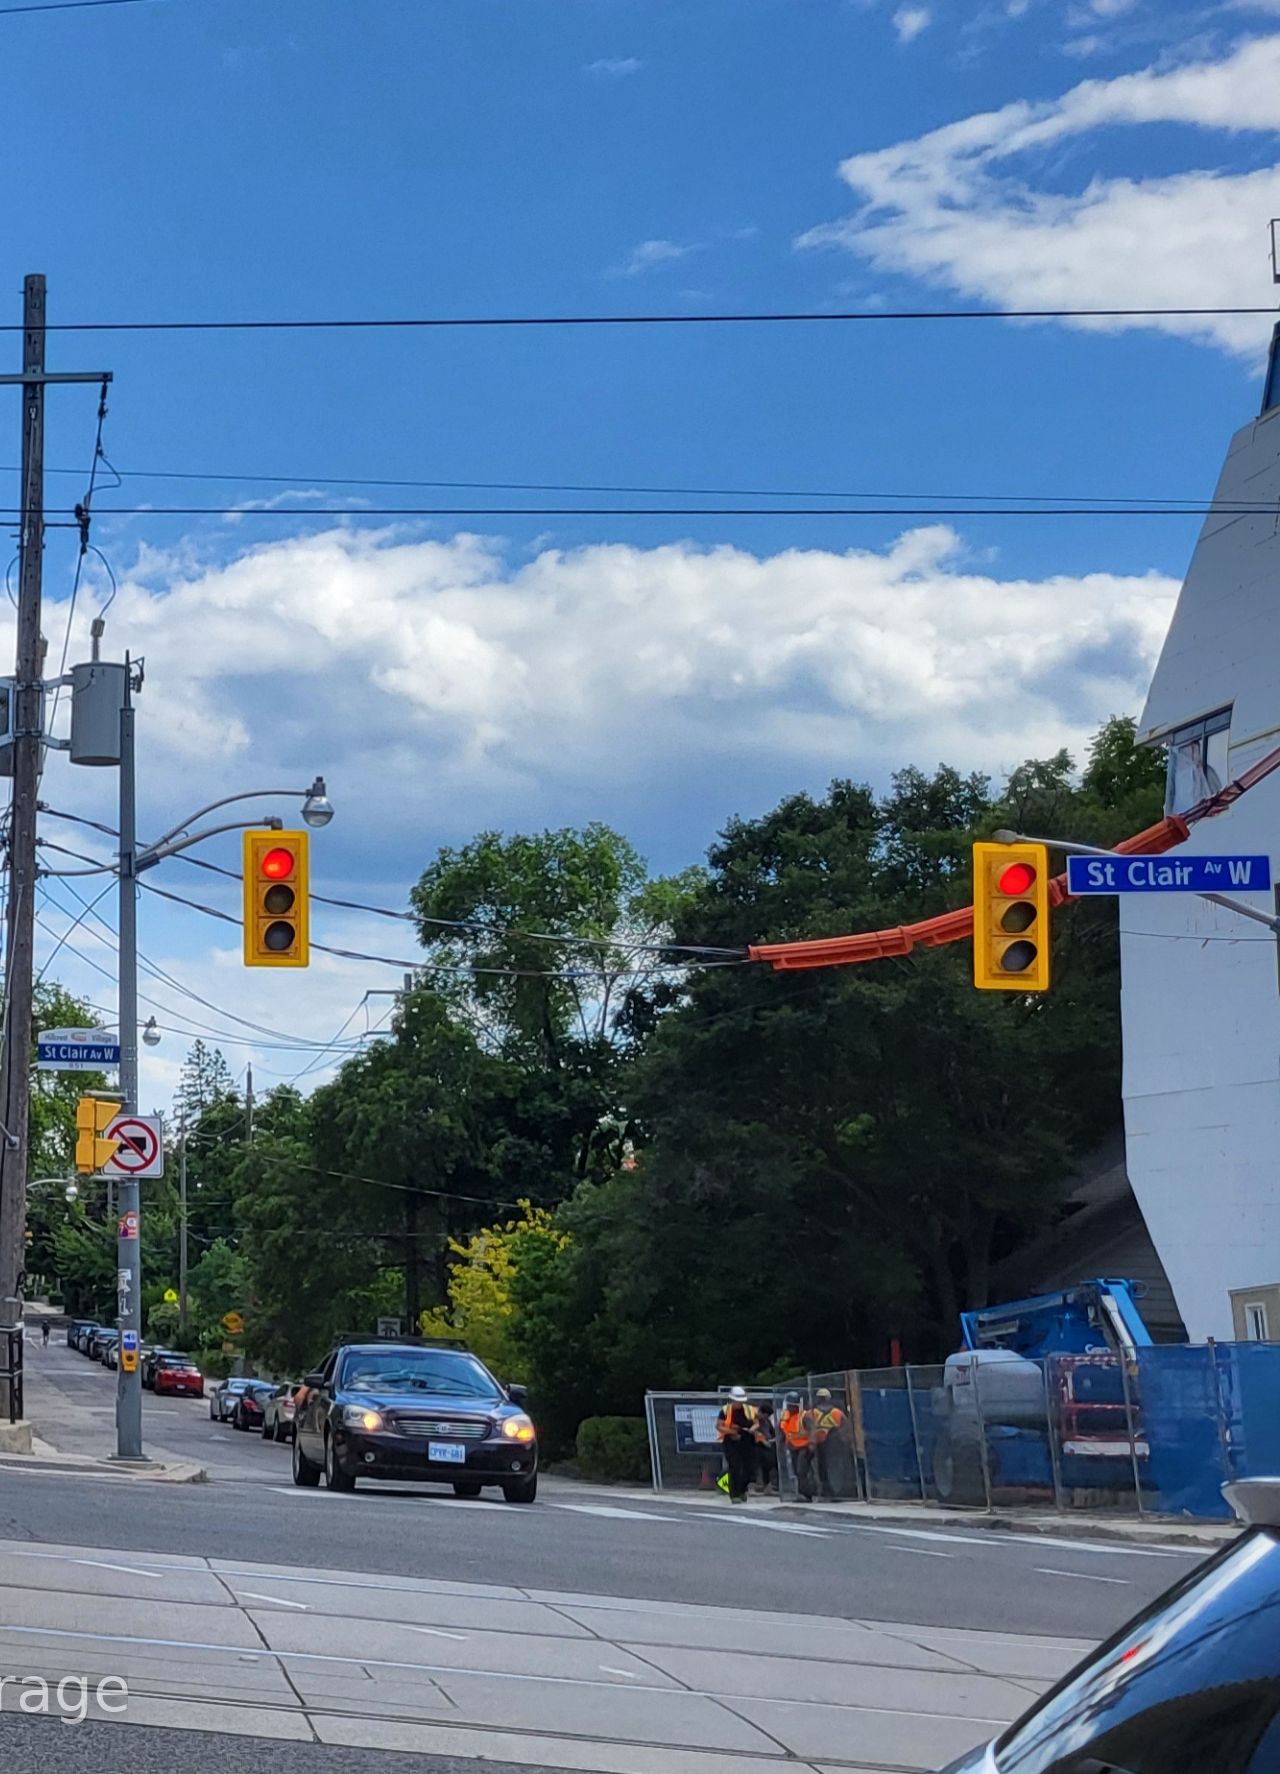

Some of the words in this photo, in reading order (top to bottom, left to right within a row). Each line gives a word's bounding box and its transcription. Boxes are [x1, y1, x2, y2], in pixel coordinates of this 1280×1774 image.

[1087, 861, 1116, 886] St
[1127, 861, 1194, 886] Clair
[1203, 861, 1222, 874] Av
[1228, 860, 1252, 885] W
[44, 1045, 57, 1059] St
[59, 1046, 89, 1060] Clair
[89, 1049, 102, 1060] Av
[103, 1047, 115, 1060] W
